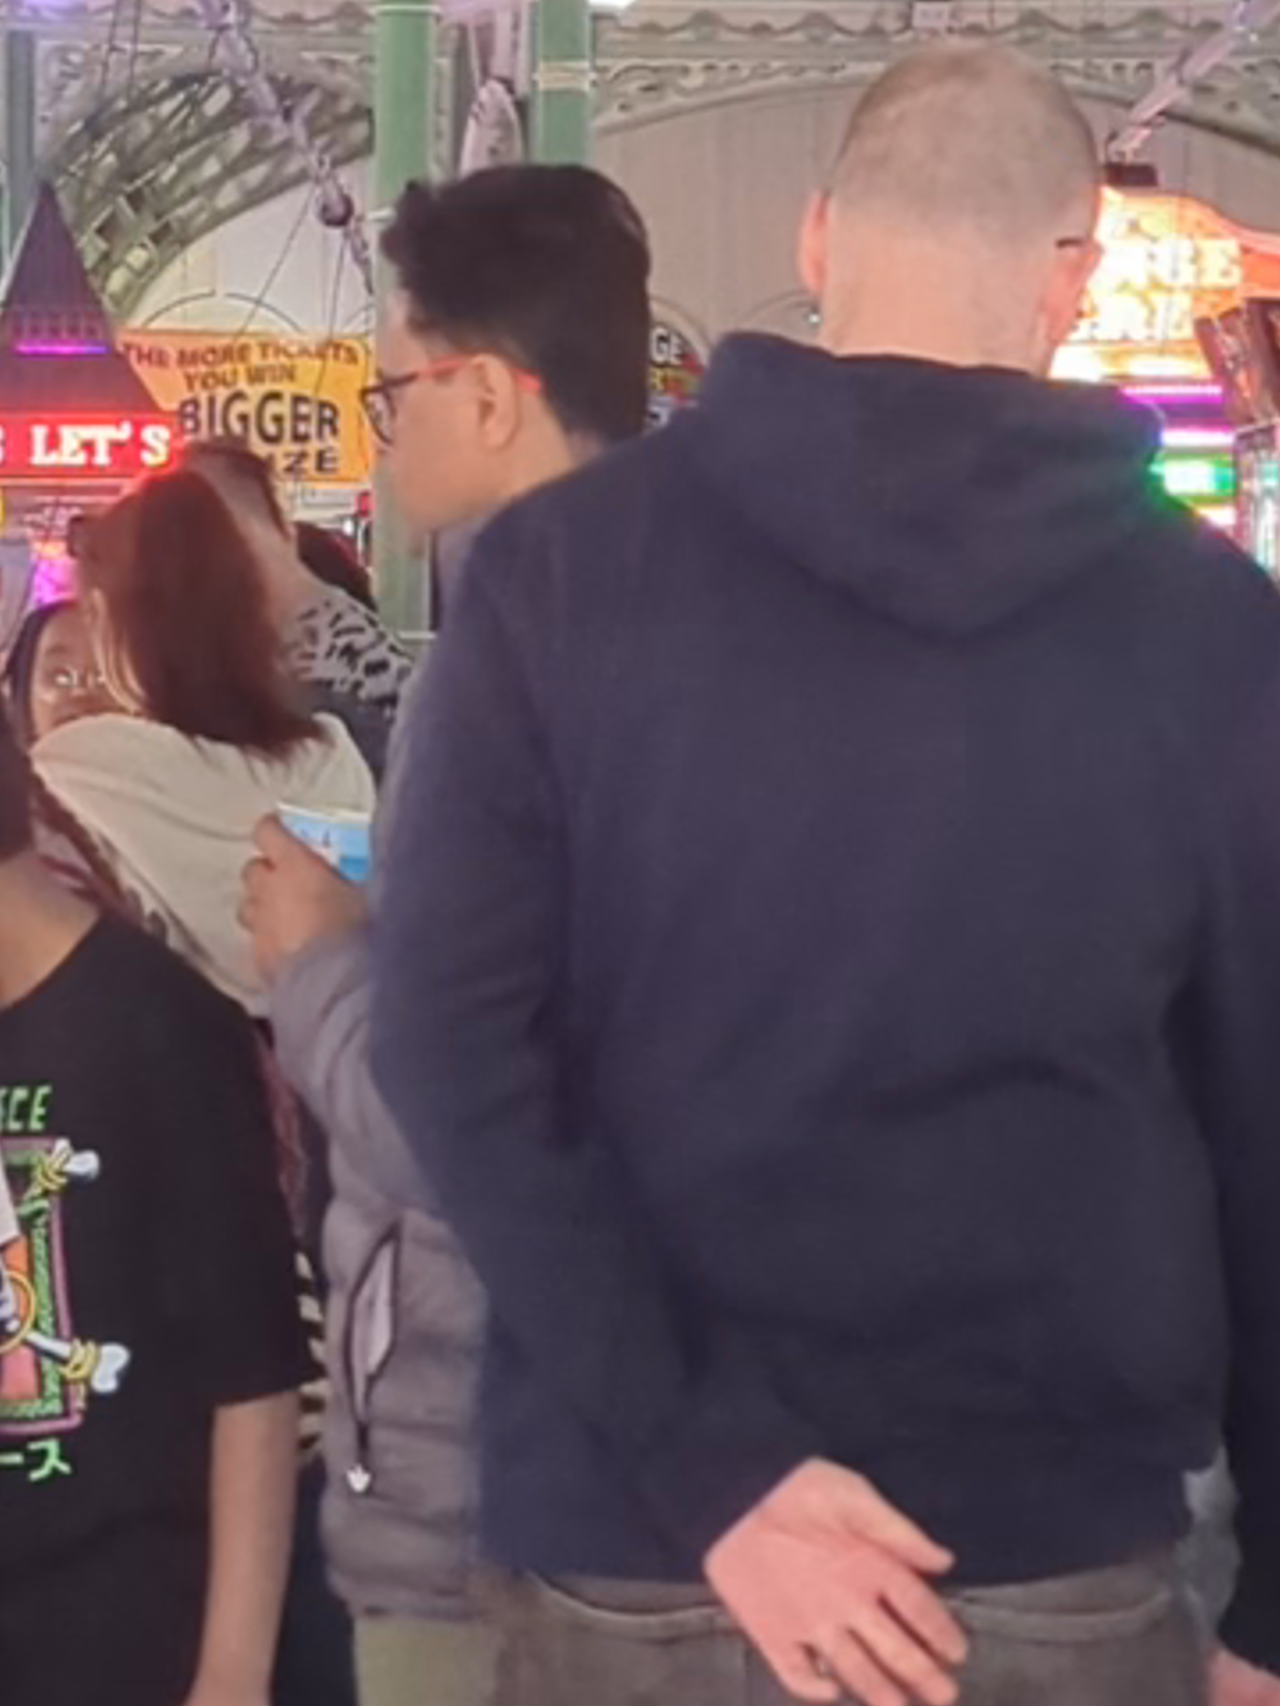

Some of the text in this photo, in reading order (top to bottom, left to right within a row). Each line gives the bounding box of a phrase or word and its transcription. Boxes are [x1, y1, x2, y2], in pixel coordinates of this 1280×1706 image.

[176, 343, 251, 366] MORE
[258, 341, 360, 364] TICKETS
[184, 364, 296, 392] YOU WIN
[179, 390, 340, 445] BIGGER
[30, 421, 172, 468] LET'S
